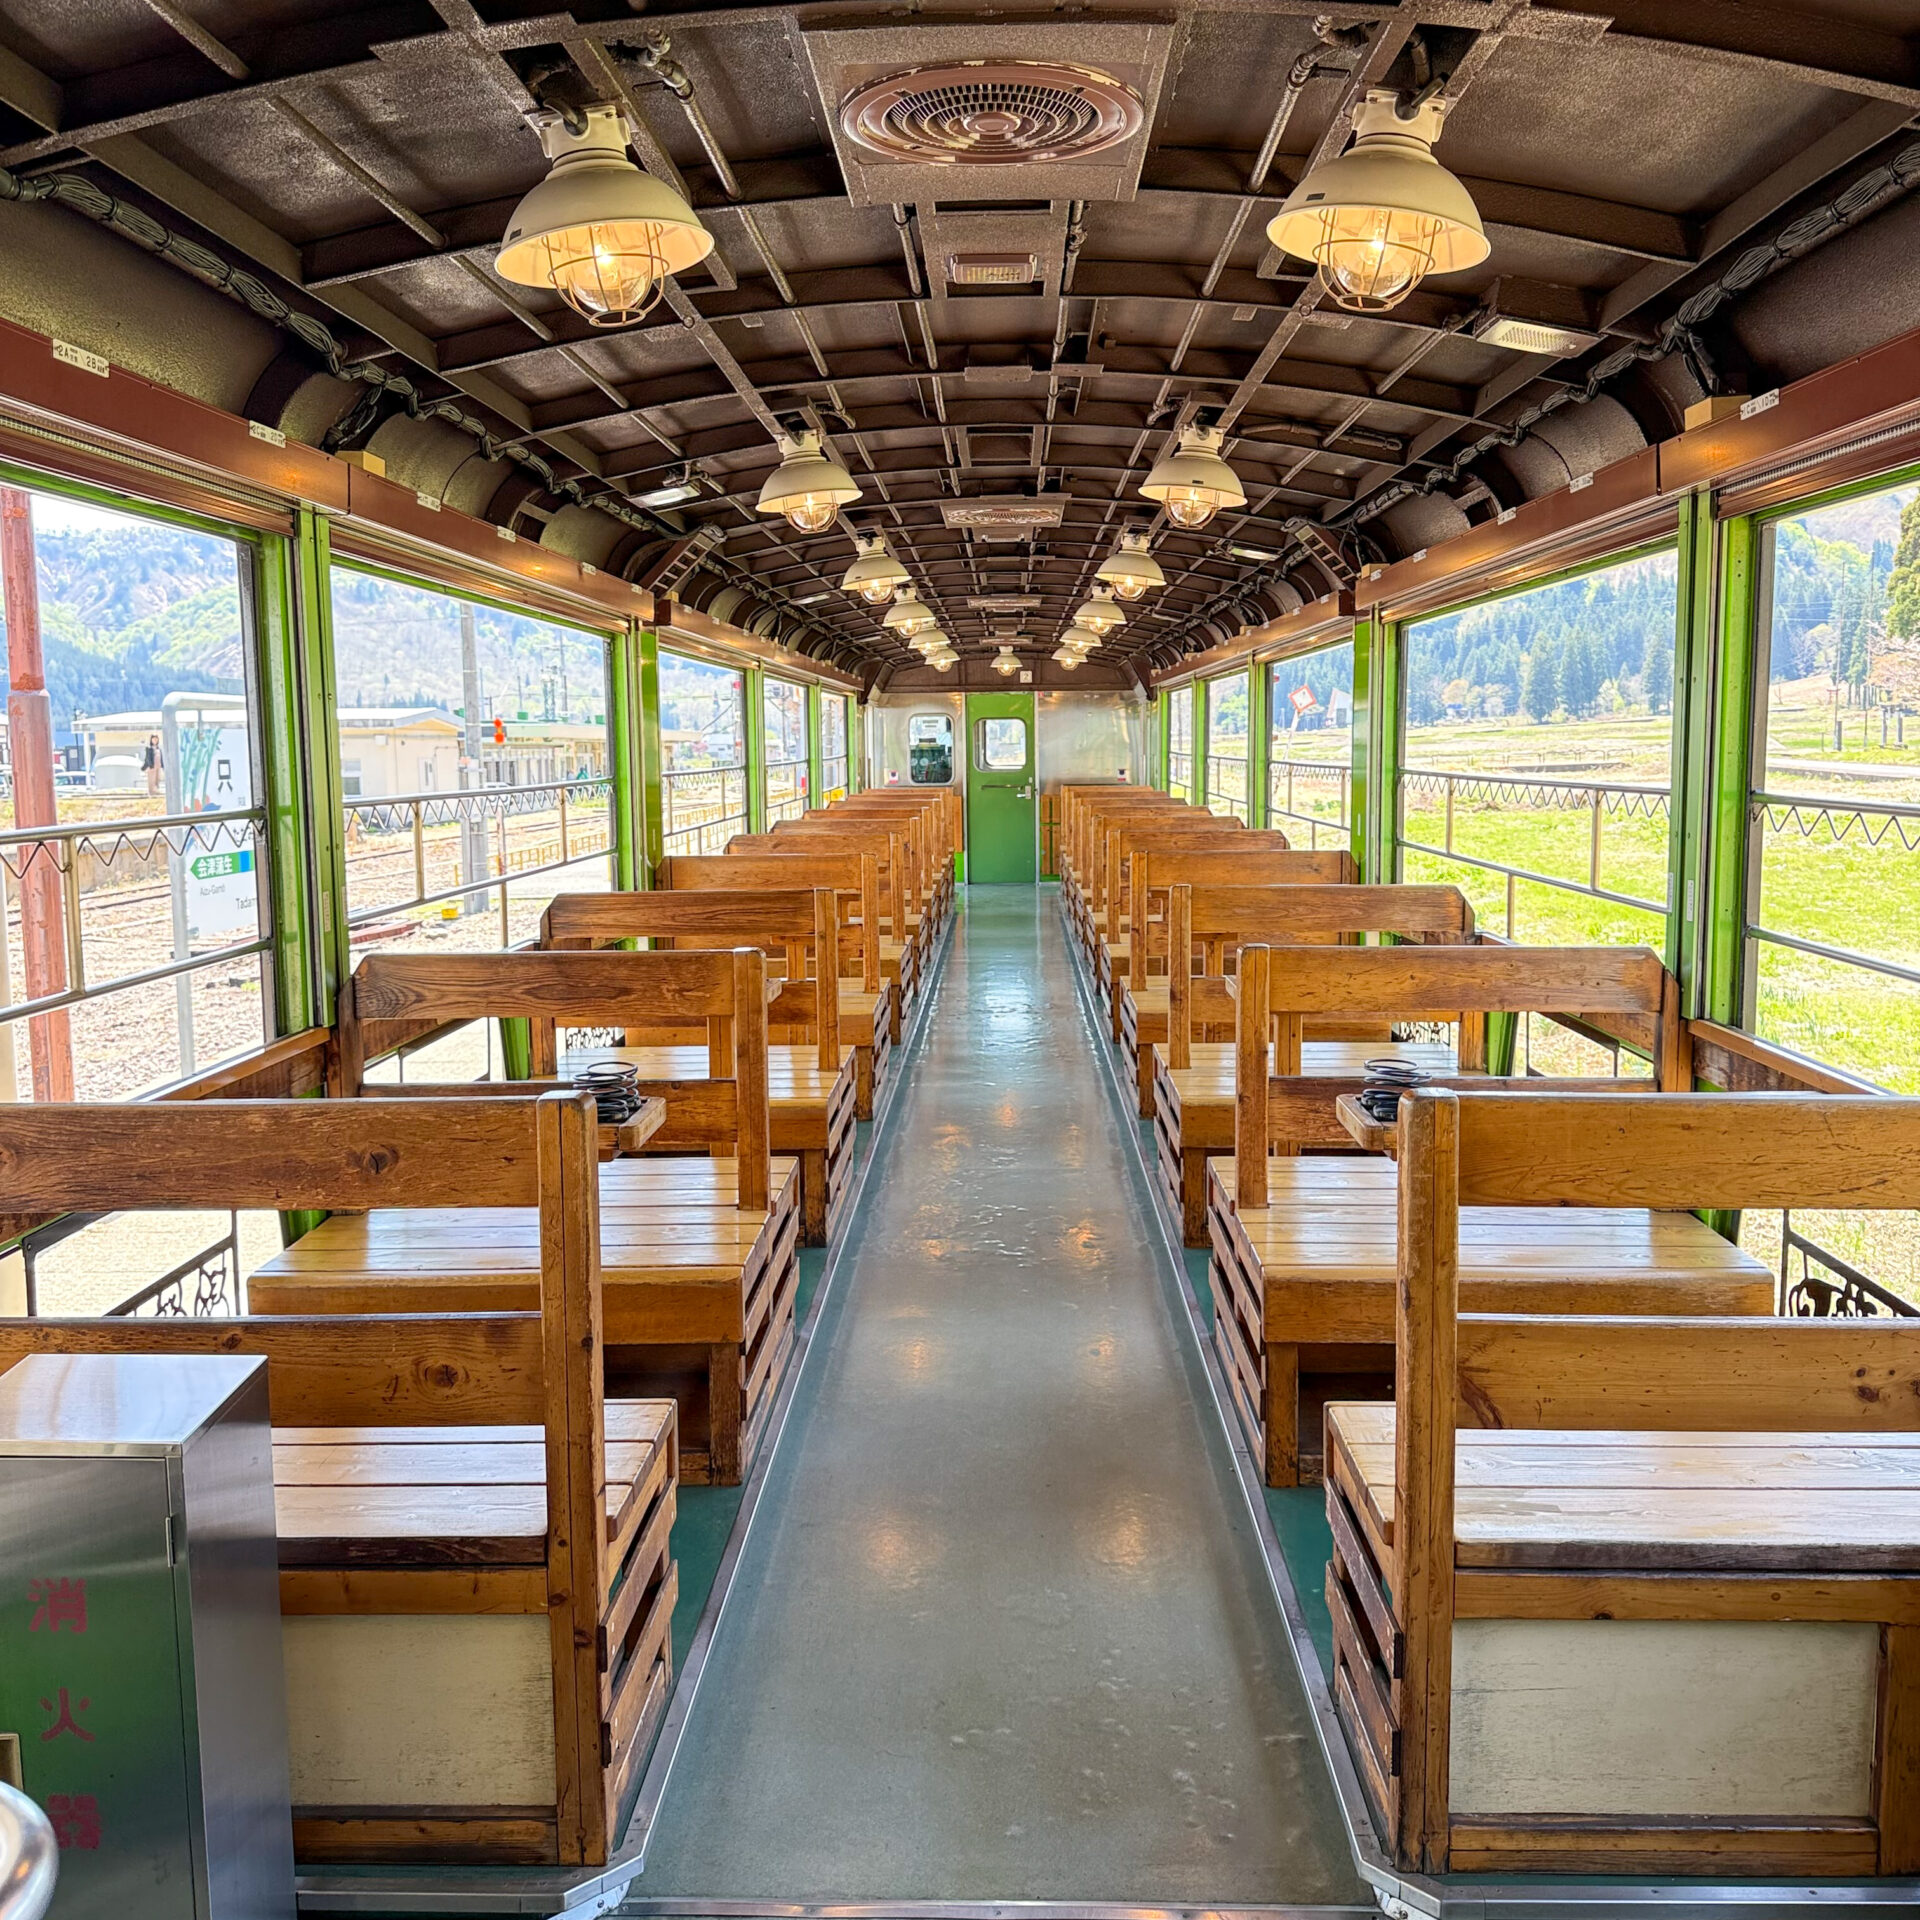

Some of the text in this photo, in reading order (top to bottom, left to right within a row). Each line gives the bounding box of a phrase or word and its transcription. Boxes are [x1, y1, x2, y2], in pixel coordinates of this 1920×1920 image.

[57, 345, 69, 358] 2A
[86, 356, 96, 369] 2B
[27, 1576, 102, 1850] 消火器
